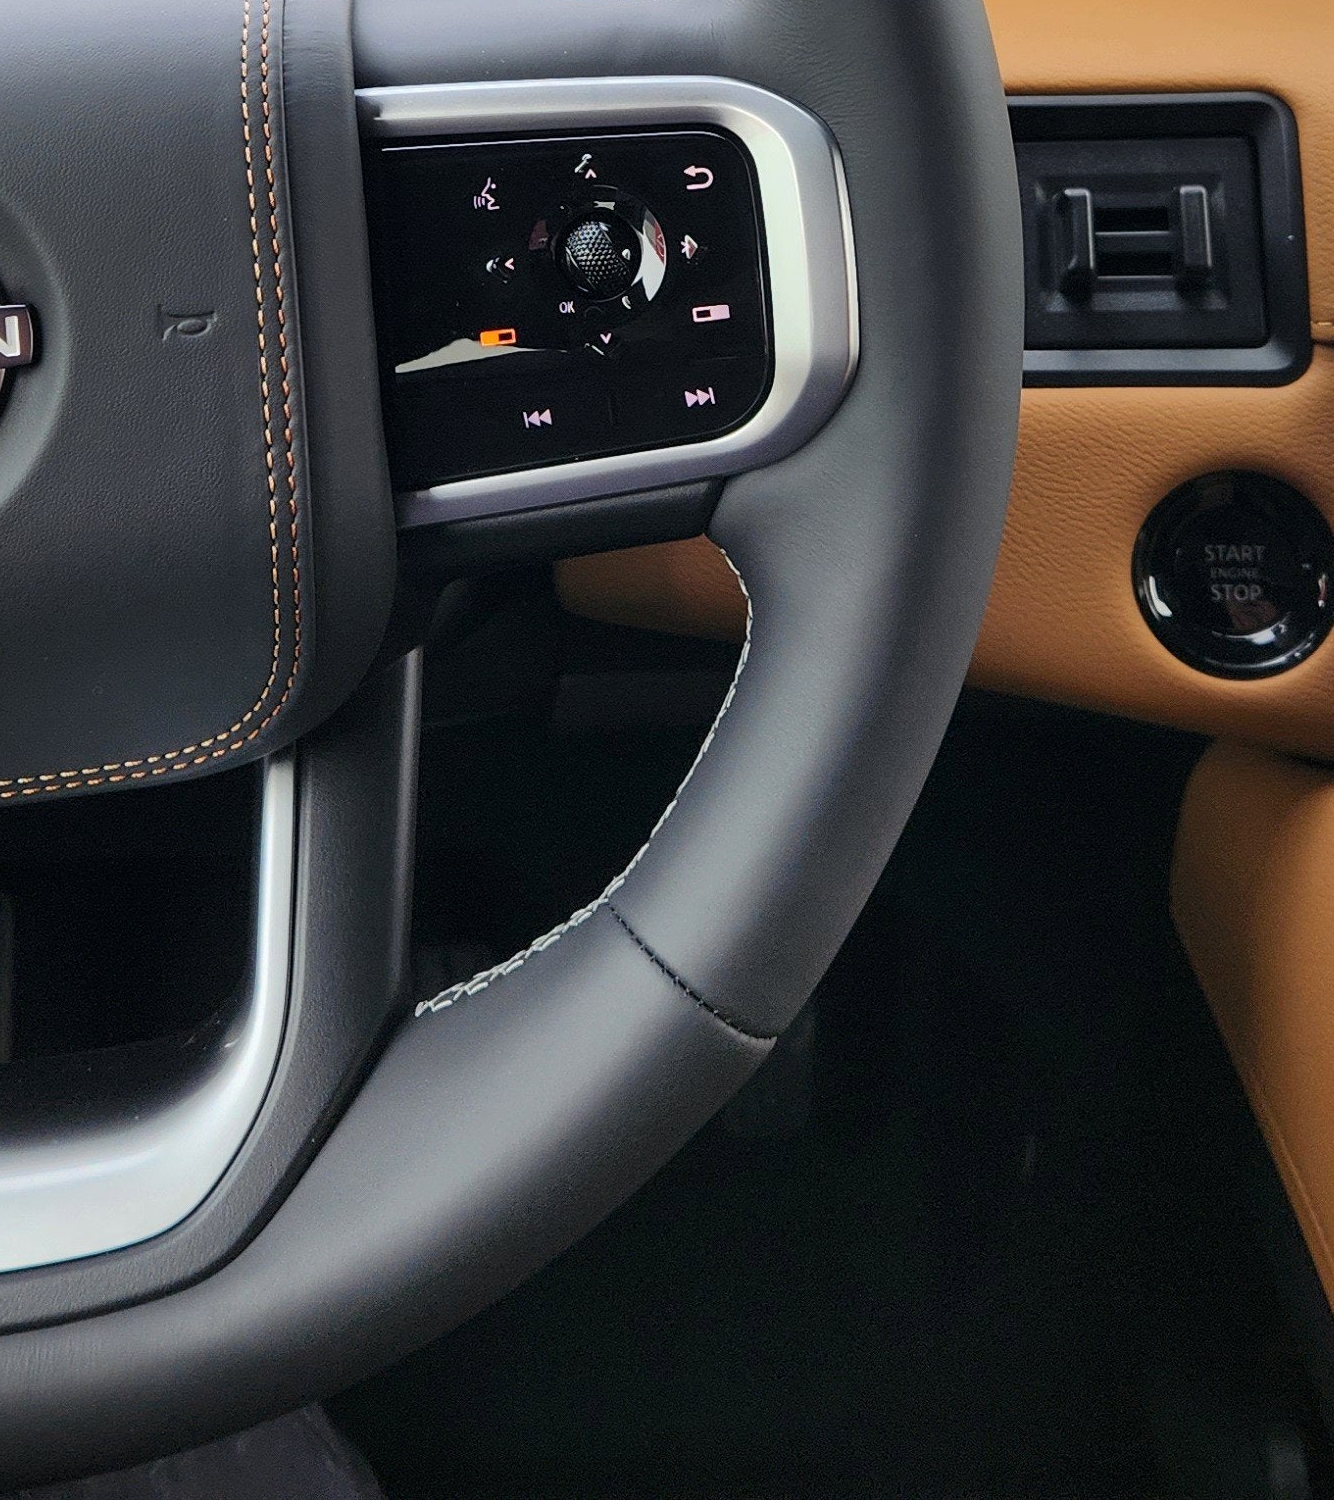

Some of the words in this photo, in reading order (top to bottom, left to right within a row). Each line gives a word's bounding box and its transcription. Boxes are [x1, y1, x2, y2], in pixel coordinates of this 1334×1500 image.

[559, 301, 576, 315] OK
[1205, 545, 1266, 561] START
[1211, 584, 1261, 601] STOP
